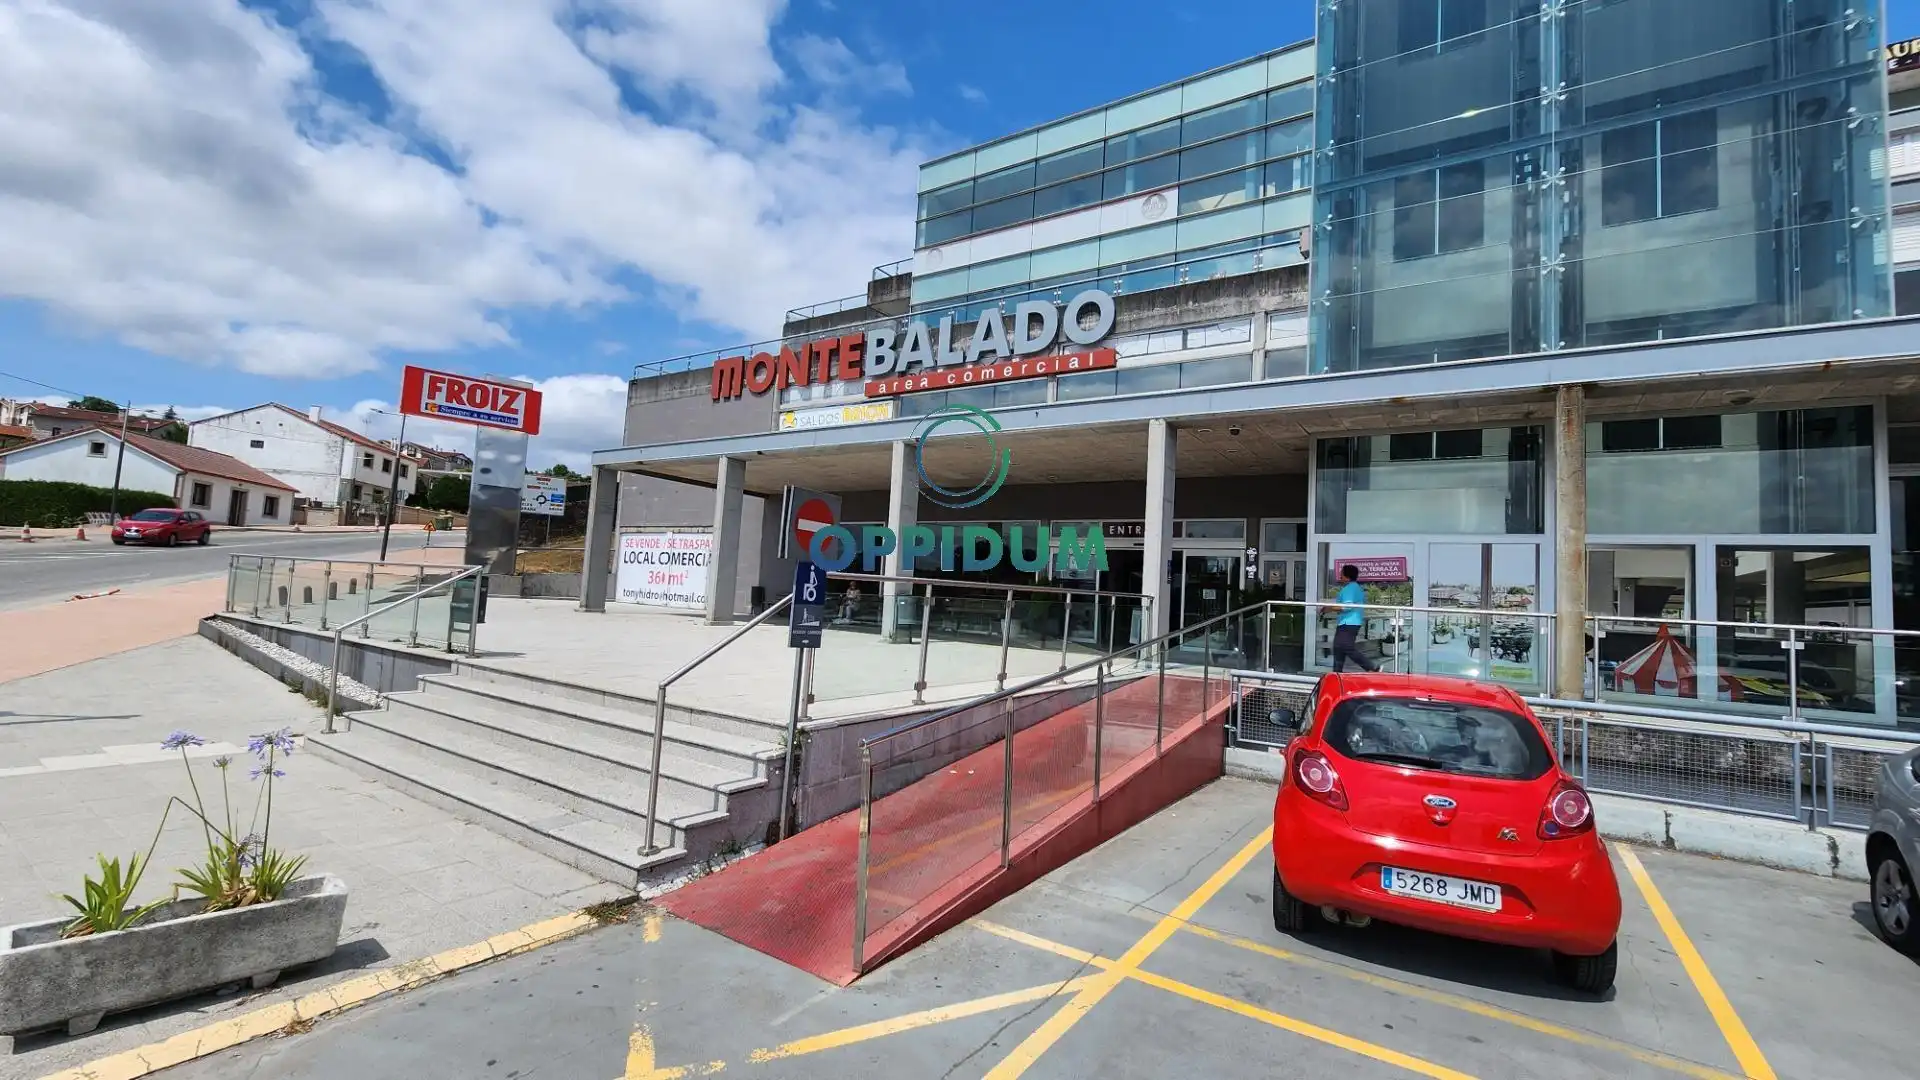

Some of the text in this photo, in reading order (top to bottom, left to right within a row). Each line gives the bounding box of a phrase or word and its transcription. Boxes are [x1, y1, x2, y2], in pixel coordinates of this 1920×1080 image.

[947, 352, 1093, 384] comercial
[427, 375, 520, 415] FROIZ
[440, 404, 471, 417] Siempre
[490, 415, 518, 425] servicio
[800, 412, 840, 427] SALDOS
[625, 538, 634, 548] SE
[634, 538, 660, 549] VENDE
[667, 539, 678, 549] SE
[623, 551, 656, 565] LOCAL
[623, 588, 709, 604] tonyhidrohotmail.co
[1396, 871, 1497, 905] 5268 JMD
